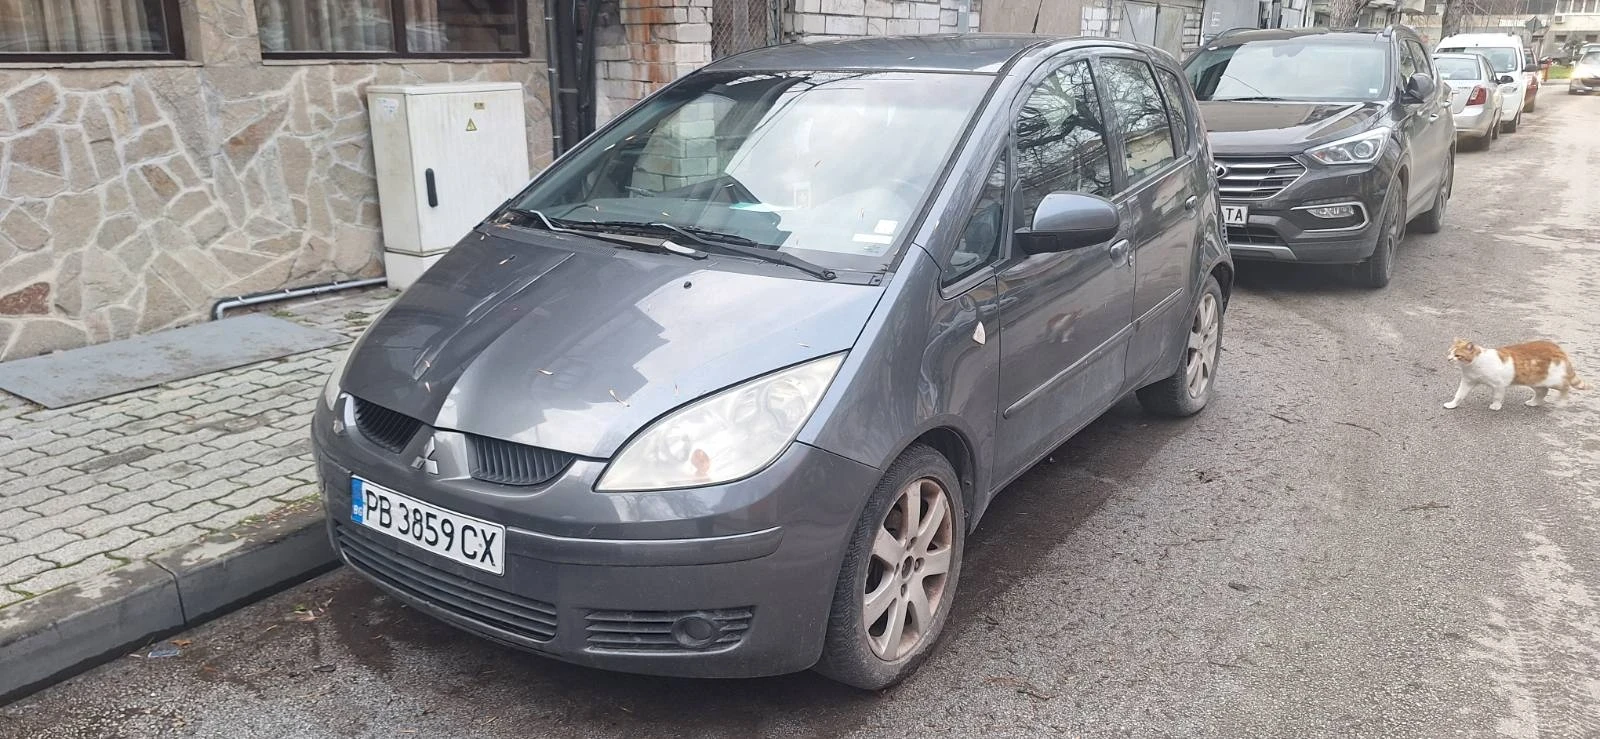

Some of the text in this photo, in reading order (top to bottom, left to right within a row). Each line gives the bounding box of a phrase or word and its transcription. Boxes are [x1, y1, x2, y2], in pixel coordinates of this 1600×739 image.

[1225, 207, 1243, 222] TA
[352, 505, 363, 516] BG
[366, 489, 496, 566] PB 3859 CX
